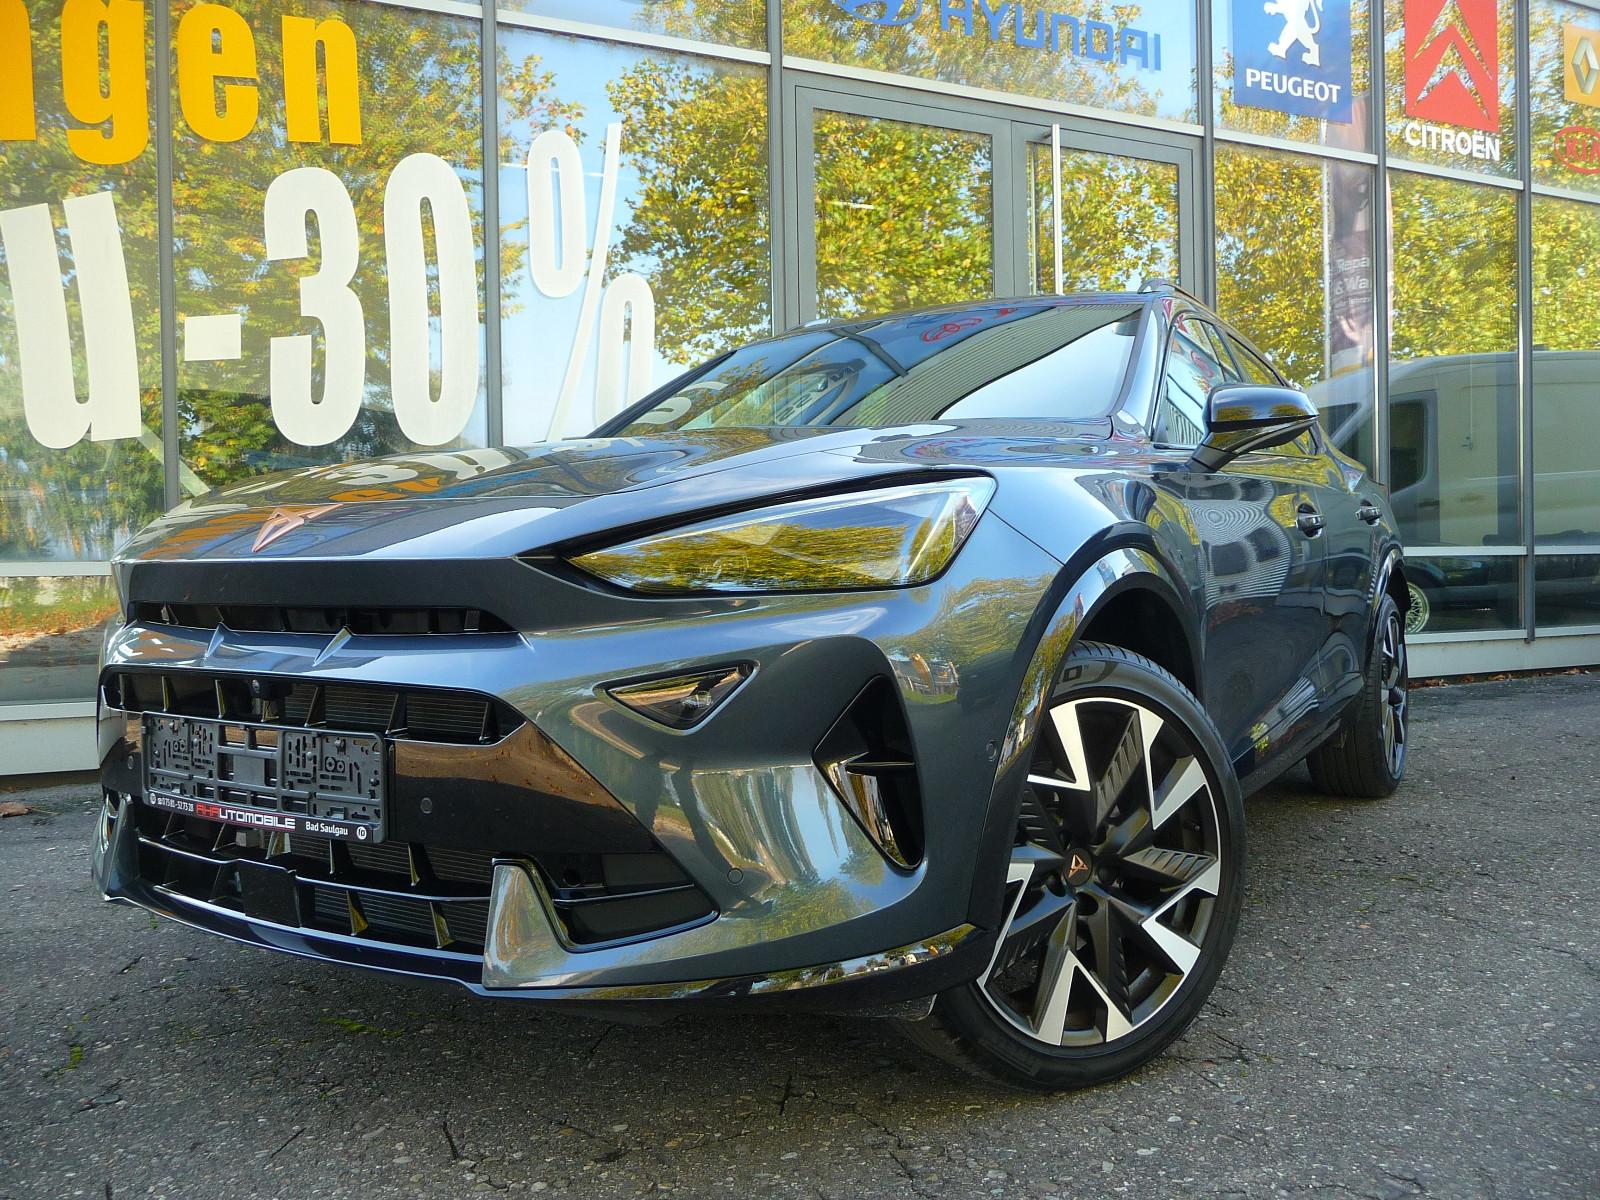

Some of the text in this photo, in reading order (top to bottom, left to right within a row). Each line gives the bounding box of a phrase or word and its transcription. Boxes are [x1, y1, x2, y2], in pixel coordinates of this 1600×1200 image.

[940, 0, 1162, 72] HYUNDAI
[1245, 68, 1341, 103] PEUGEOT
[1405, 122, 1500, 162] CITROËN
[305, 821, 319, 832] Bad
[320, 822, 348, 836] Saulgau
